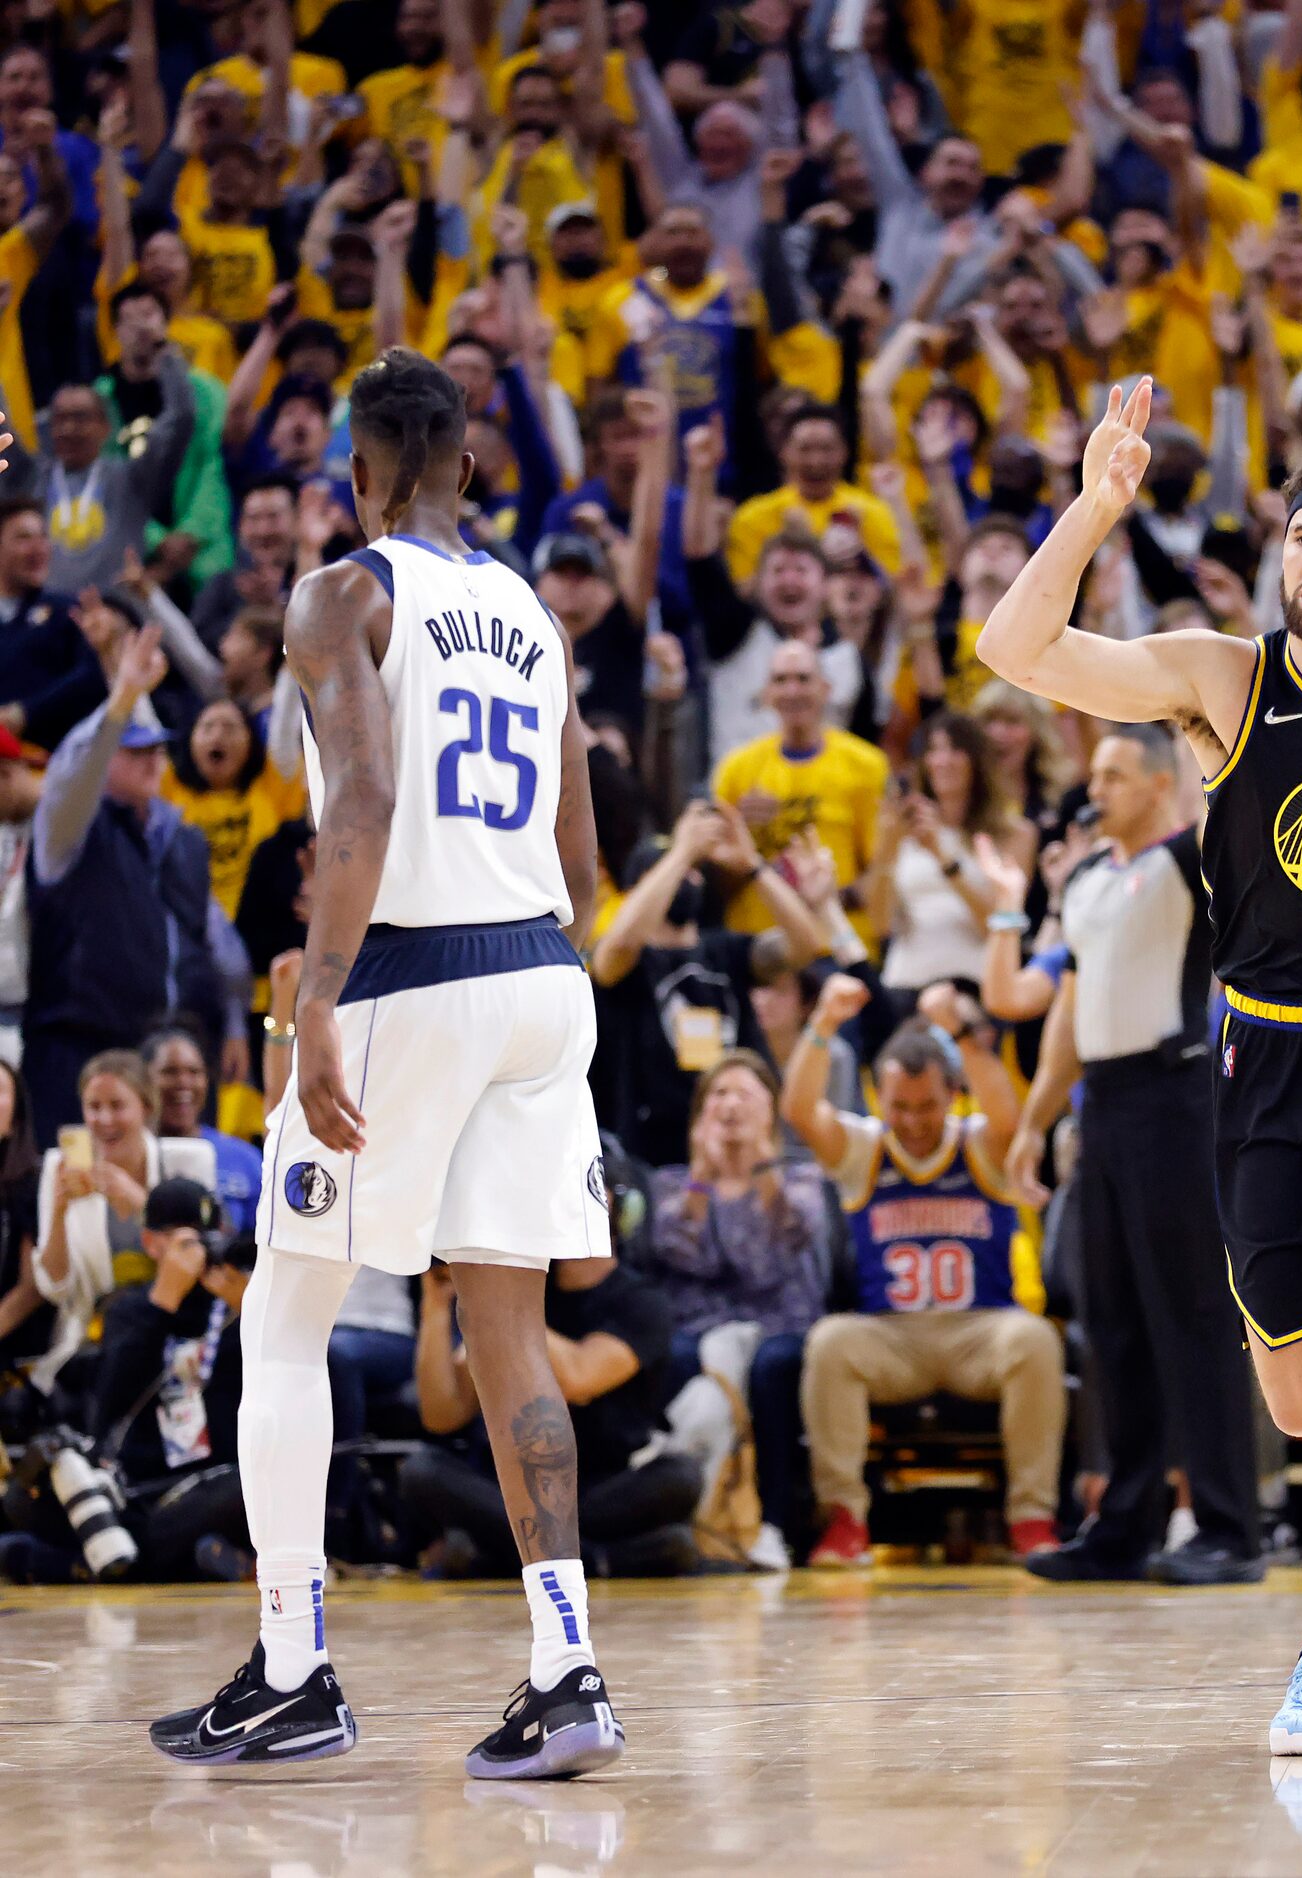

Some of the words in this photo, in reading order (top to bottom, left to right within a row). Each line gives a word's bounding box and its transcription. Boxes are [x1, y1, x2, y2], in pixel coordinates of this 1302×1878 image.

[424, 609, 545, 682] BULLOCK
[436, 687, 539, 831] 25
[882, 1240, 976, 1312] 30
